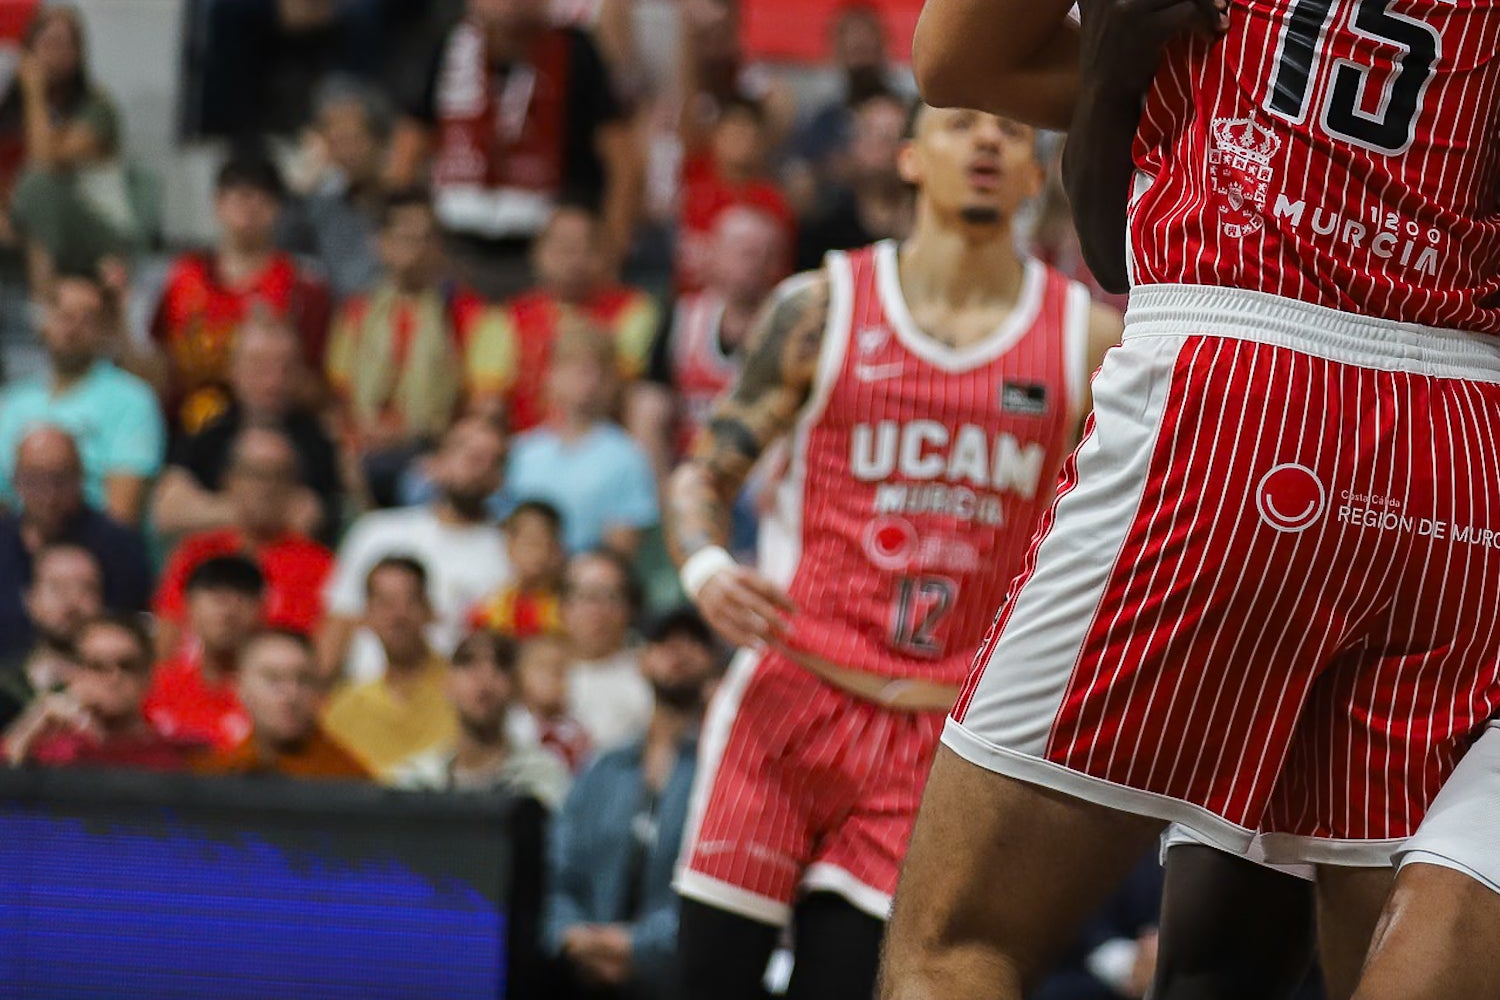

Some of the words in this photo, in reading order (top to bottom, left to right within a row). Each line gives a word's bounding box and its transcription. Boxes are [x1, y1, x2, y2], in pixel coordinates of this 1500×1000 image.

[1273, 193, 1438, 276] MURCIA
[1370, 206, 1441, 244] 1200
[852, 418, 1046, 500] UCAM
[873, 482, 1004, 526] MURCIA
[1337, 505, 1414, 533] REGIÓN
[1418, 518, 1447, 539] DE
[892, 574, 957, 656] 12
